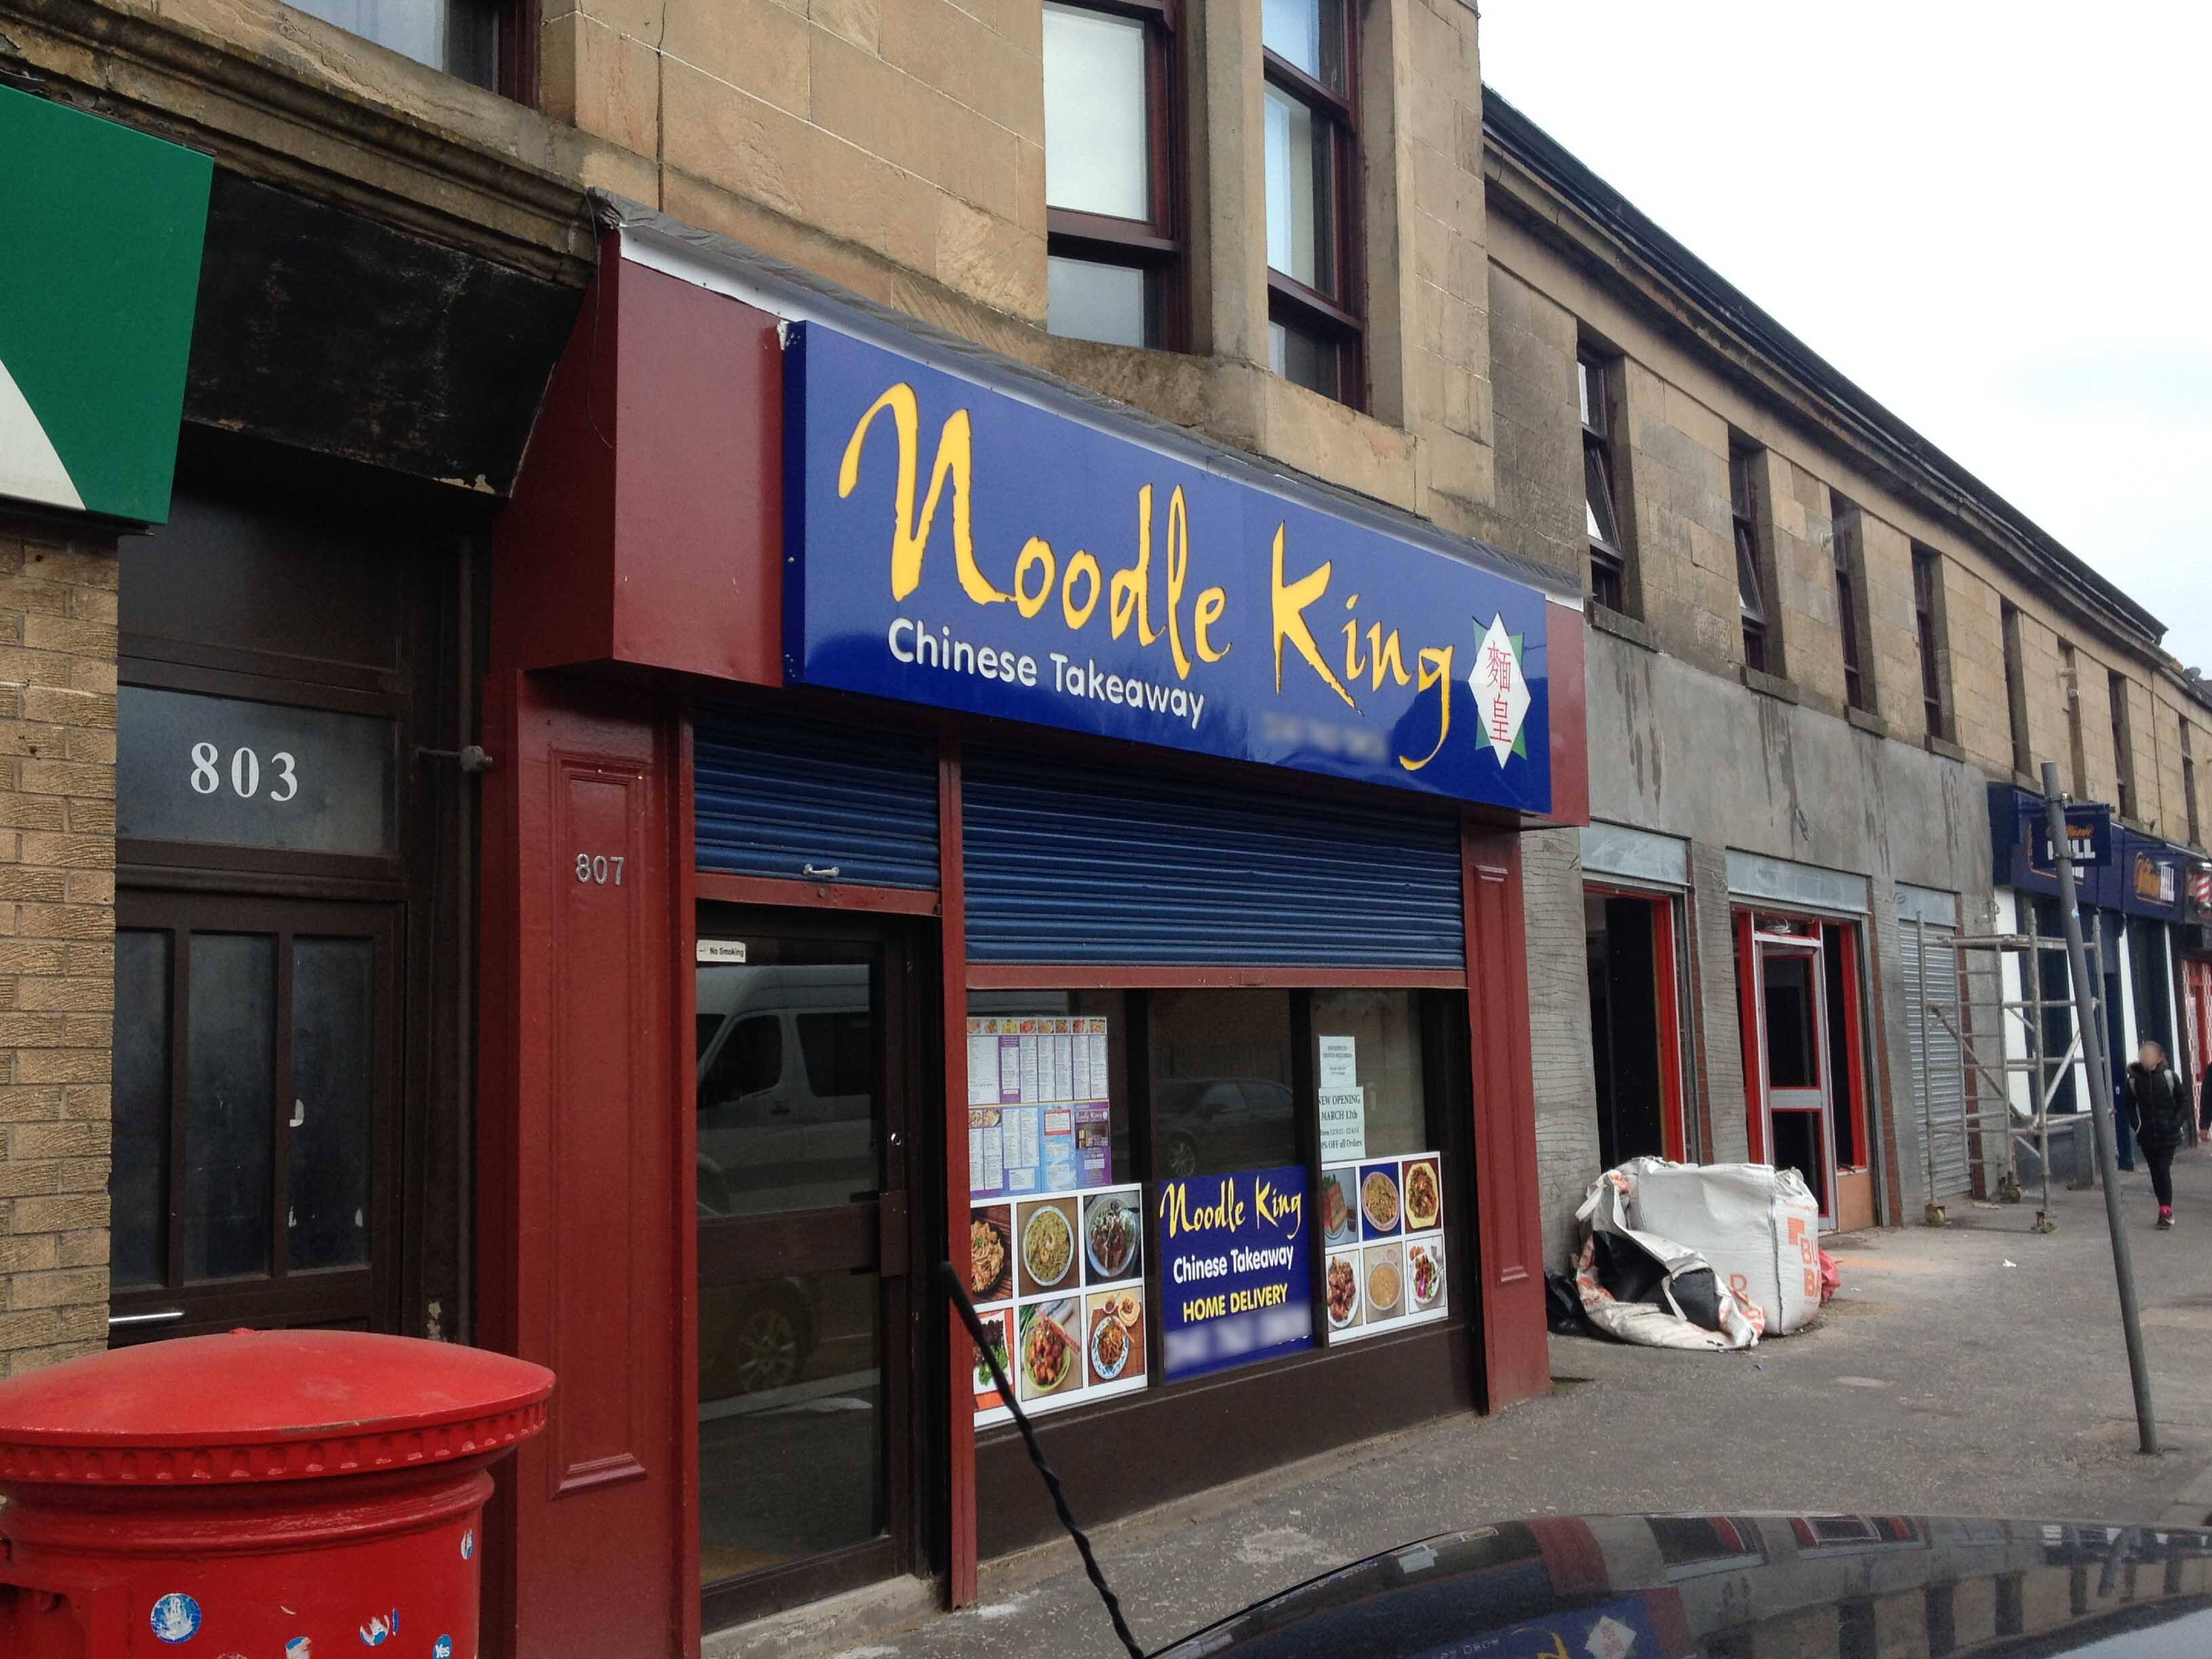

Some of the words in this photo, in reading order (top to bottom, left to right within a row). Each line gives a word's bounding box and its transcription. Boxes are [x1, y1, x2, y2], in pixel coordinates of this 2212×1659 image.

[838, 381, 1233, 680] Noodle
[1271, 519, 1455, 771] King
[887, 617, 1038, 687] Chinese
[1049, 652, 1204, 729] Takeaway
[190, 742, 298, 802] 803
[575, 853, 625, 886] 807
[710, 947, 718, 955] No
[719, 947, 743, 958] Smoking
[1321, 1111, 1344, 1121] MARCH
[1332, 1094, 1360, 1105] OPENING
[1160, 1176, 1246, 1238] Noodle
[1256, 1175, 1302, 1240] King
[1173, 1254, 1227, 1284] Chinese
[1231, 1245, 1294, 1271] Takeaway
[1183, 1294, 1226, 1324] HOME
[1231, 1283, 1288, 1313] DELIVERY
